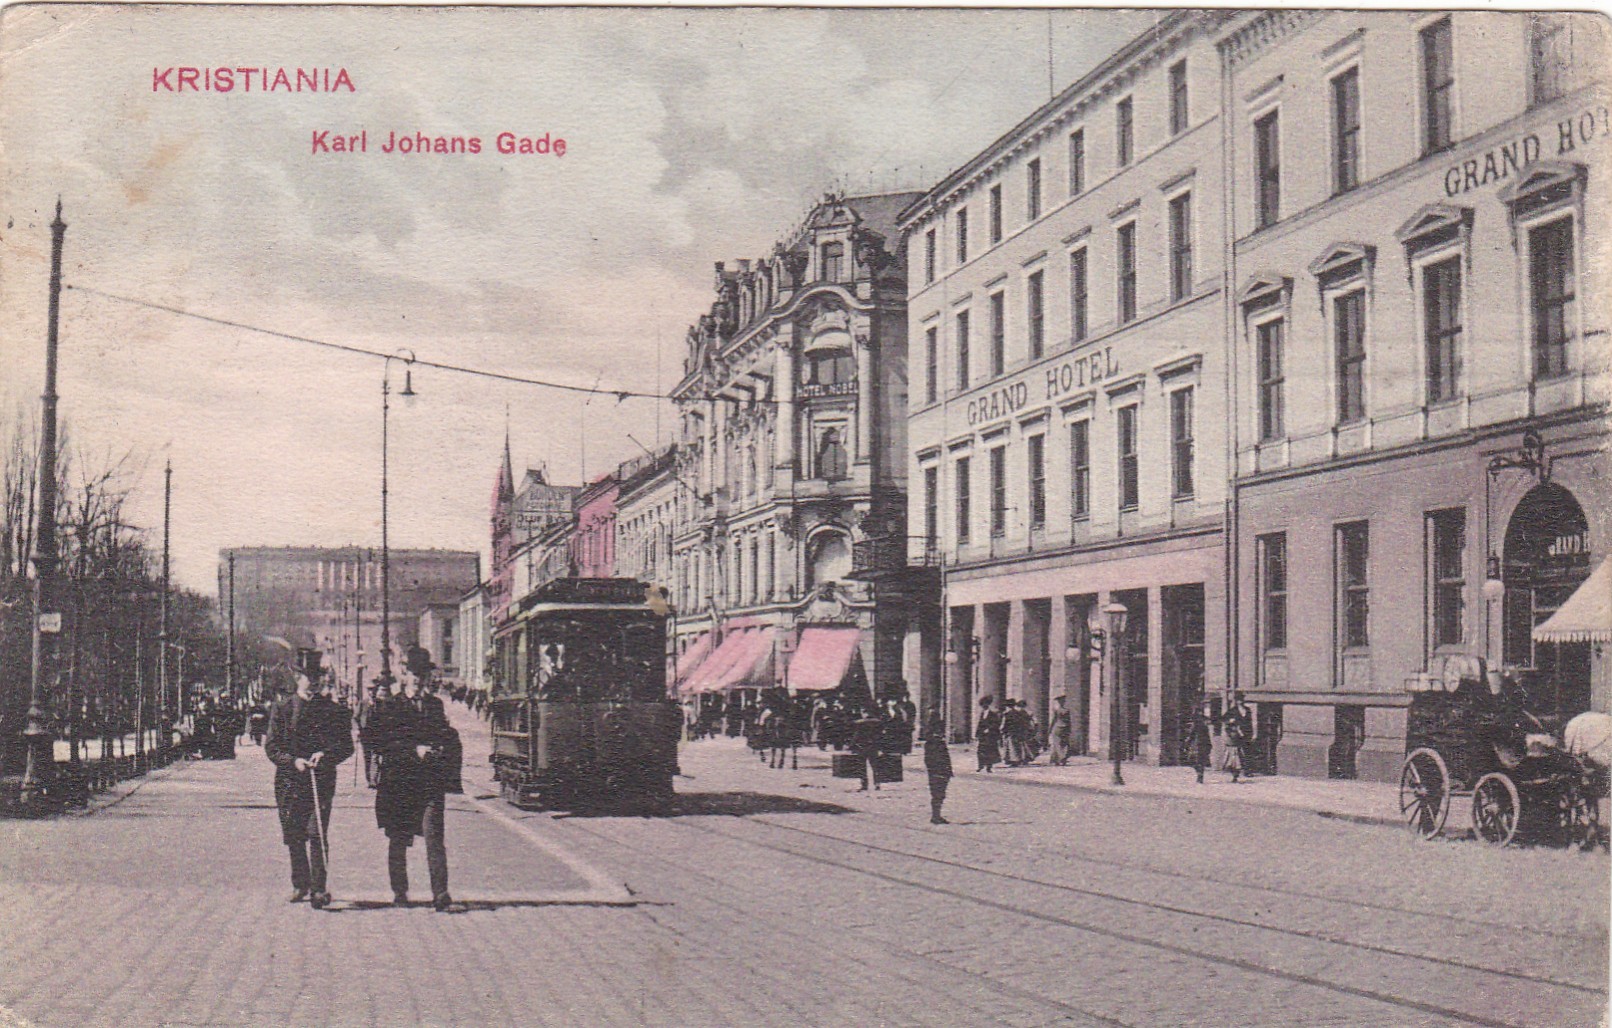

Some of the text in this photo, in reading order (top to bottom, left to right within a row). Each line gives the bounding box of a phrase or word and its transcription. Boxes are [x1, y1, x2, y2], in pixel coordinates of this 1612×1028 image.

[1444, 134, 1541, 197] GRAND
[796, 382, 859, 398] HOTEL NOBEL
[967, 346, 1120, 425] GRAND HOTEL
